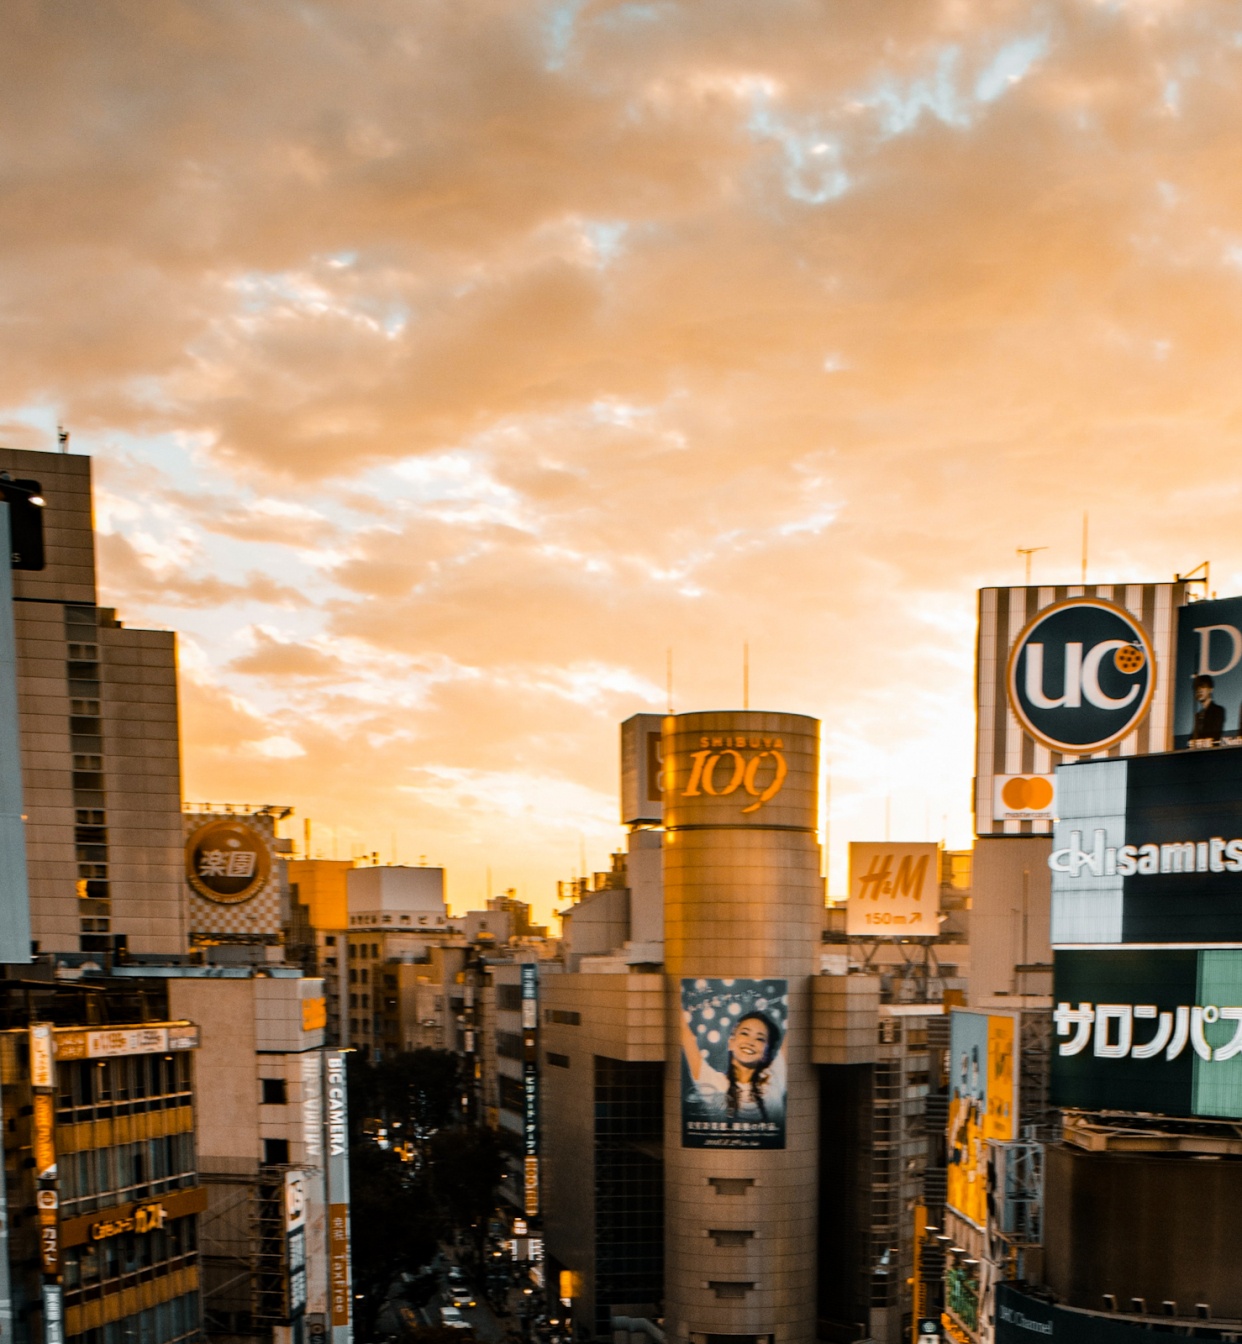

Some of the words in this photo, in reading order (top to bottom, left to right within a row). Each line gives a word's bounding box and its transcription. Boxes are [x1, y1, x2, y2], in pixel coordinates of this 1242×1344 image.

[700, 737, 784, 749] SHIBUYA
[681, 749, 788, 809] 109
[200, 850, 257, 878] 楽園
[858, 854, 931, 901] H&M
[865, 912, 907, 925] 150m
[327, 1058, 338, 1084] BIC
[328, 1088, 345, 1156] CAMERA
[42, 1227, 57, 1266] ガスト
[1014, 1311, 1054, 1335] Channel
